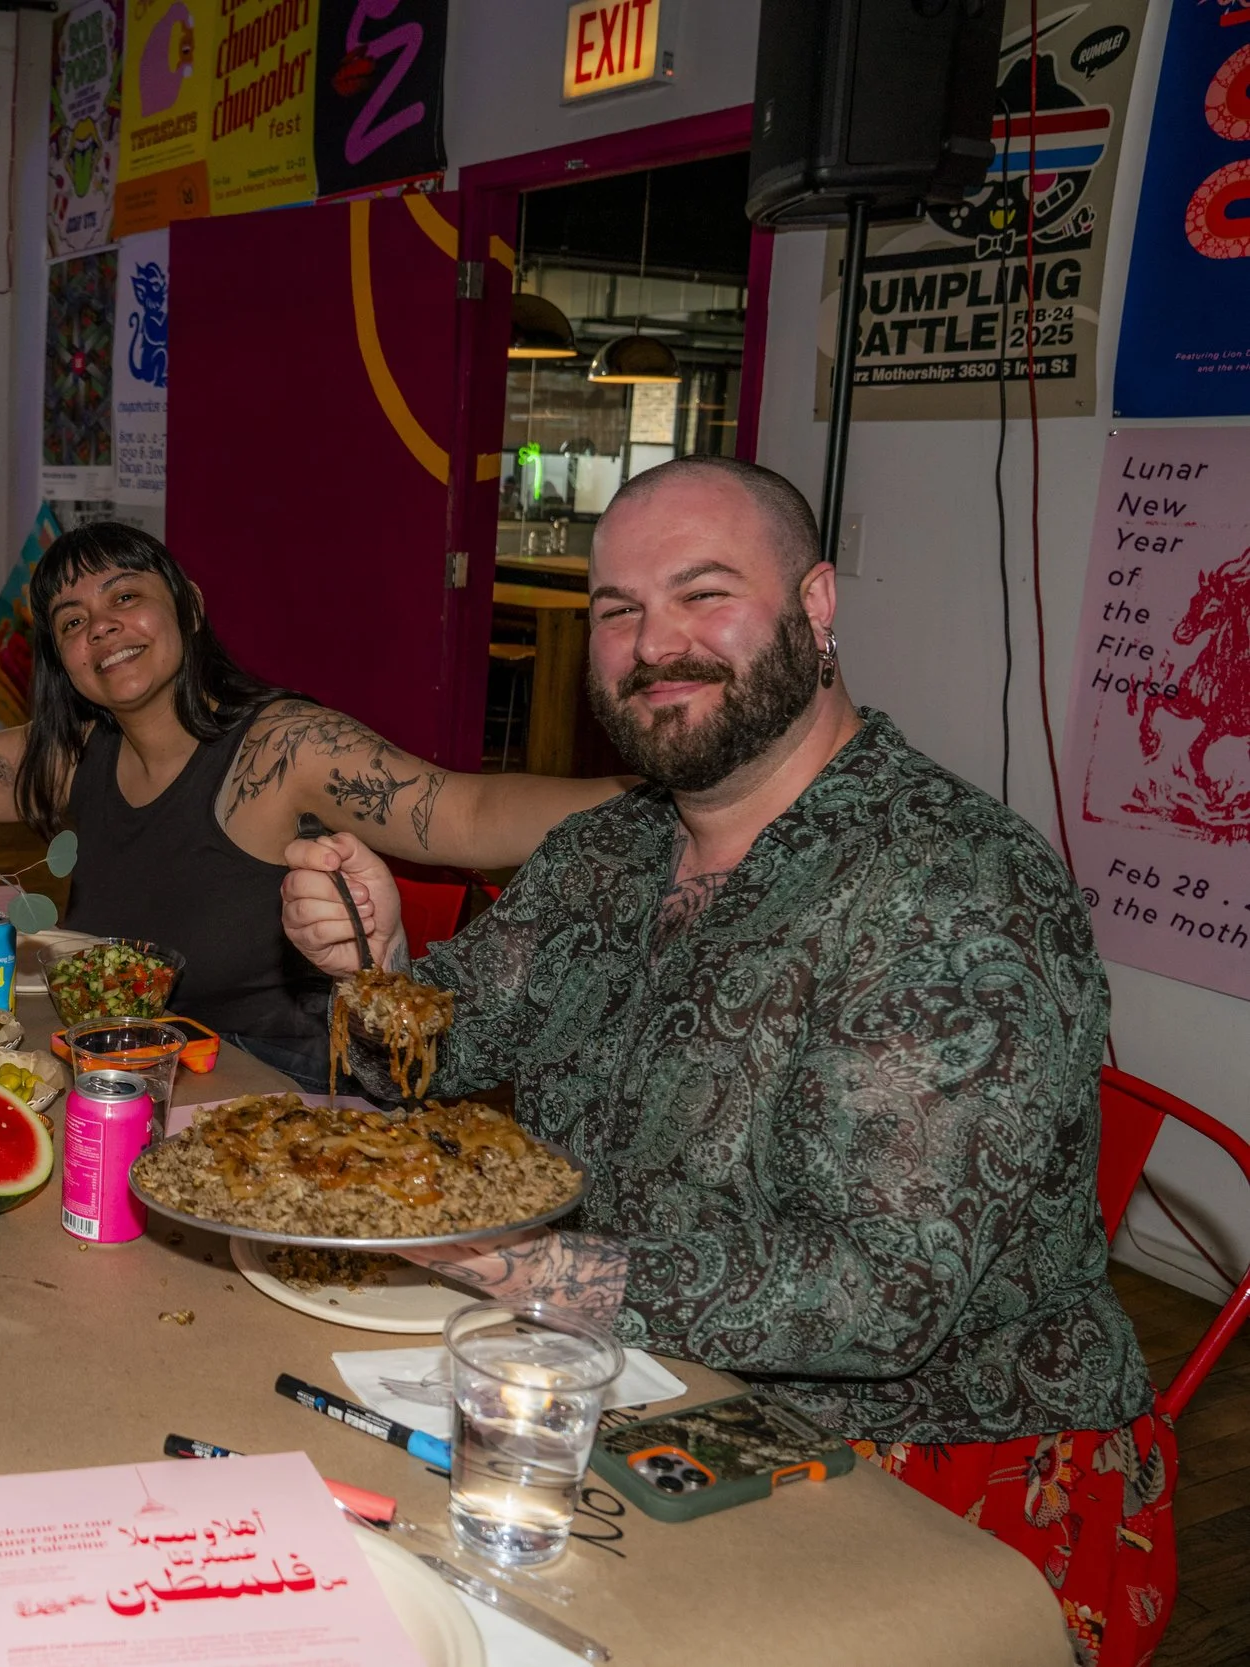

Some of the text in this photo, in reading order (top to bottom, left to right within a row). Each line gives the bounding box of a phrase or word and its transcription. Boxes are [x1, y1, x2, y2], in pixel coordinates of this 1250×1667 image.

[575, 0, 653, 84] EXIT
[1078, 31, 1124, 65] RUMBLE!
[269, 114, 301, 139] fest
[857, 258, 1082, 315] UMPLING
[856, 312, 999, 357] ATTLE
[1010, 323, 1074, 348] 2025
[1175, 350, 1243, 361] Featuring Lion
[1197, 364, 1215, 373] and
[1217, 363, 1234, 373] the
[872, 365, 955, 382] Mothership:
[959, 362, 997, 378] 3630
[1050, 358, 1070, 374] St
[1122, 456, 1209, 481] Lunar
[1117, 492, 1187, 518] New
[1116, 528, 1184, 554] Year
[1108, 567, 1142, 586] of
[1103, 600, 1150, 624] the
[1096, 634, 1155, 661] Fire
[1092, 668, 1180, 699] Horse
[1108, 858, 1210, 899] Feb 28
[1112, 897, 1157, 924] the
[1170, 913, 1249, 949] moth
[107, 1553, 316, 1617] فلسطين
